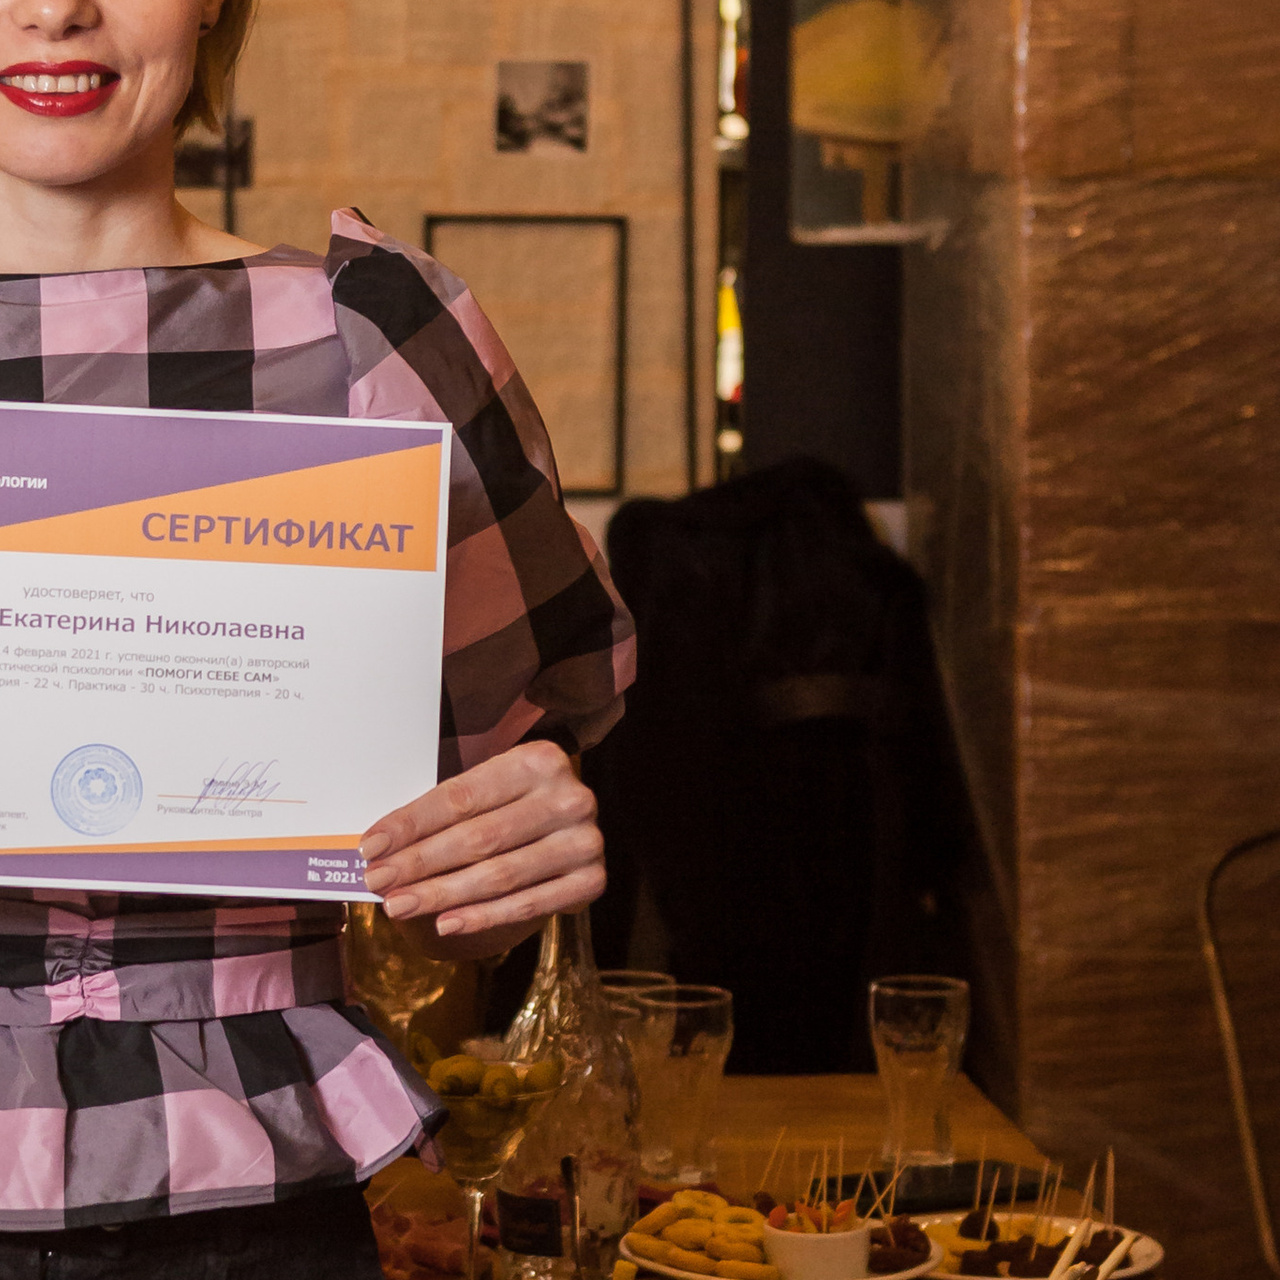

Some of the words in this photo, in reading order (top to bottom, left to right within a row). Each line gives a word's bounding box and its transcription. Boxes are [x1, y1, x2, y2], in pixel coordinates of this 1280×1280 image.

[141, 512, 414, 553] СЕРТИФИКАТ
[23, 585, 125, 603] удостоверяет,
[130, 590, 155, 602] что
[0, 607, 135, 634] Екатерина
[145, 614, 305, 640] Николаевна
[13, 644, 67, 660] февраля
[71, 648, 100, 660] 2021
[117, 651, 171, 664] успешно
[174, 653, 244, 668] окончил(а)
[246, 656, 310, 670] авторский
[62, 663, 133, 678] психологии
[137, 667, 203, 680] «ПОМОГИ
[206, 670, 240, 682] СЕБЕ
[243, 672, 280, 684] САМ»
[33, 677, 49, 689] 22
[68, 679, 127, 693] Практика
[140, 682, 155, 694] 30
[175, 684, 261, 700] Психотерапия
[274, 689, 290, 700] 20
[228, 806, 263, 818] центра
[307, 857, 349, 869] Москва
[307, 870, 322, 882] №
